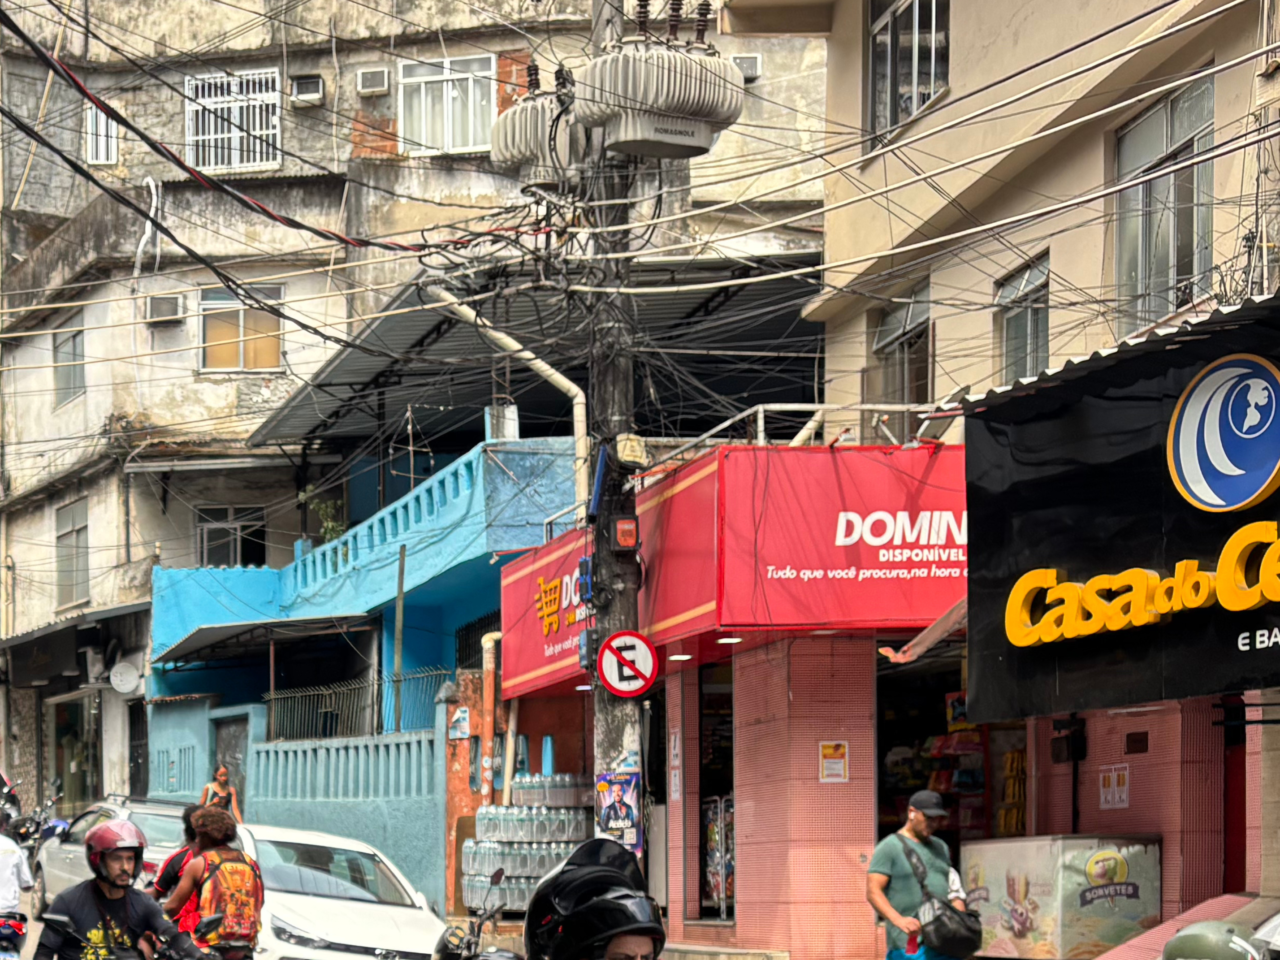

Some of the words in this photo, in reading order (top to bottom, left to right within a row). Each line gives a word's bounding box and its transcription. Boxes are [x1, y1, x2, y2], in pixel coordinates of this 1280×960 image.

[835, 510, 968, 546] DOMIN
[878, 546, 967, 562] DISPONÍVEL
[766, 565, 797, 580] Tudo
[800, 569, 824, 582] que
[827, 566, 857, 579] você
[931, 564, 960, 578] hora
[1005, 568, 1160, 648] Casa
[1154, 559, 1212, 614] do
[1237, 632, 1250, 651] E
[1084, 884, 1134, 901] SORVETES
